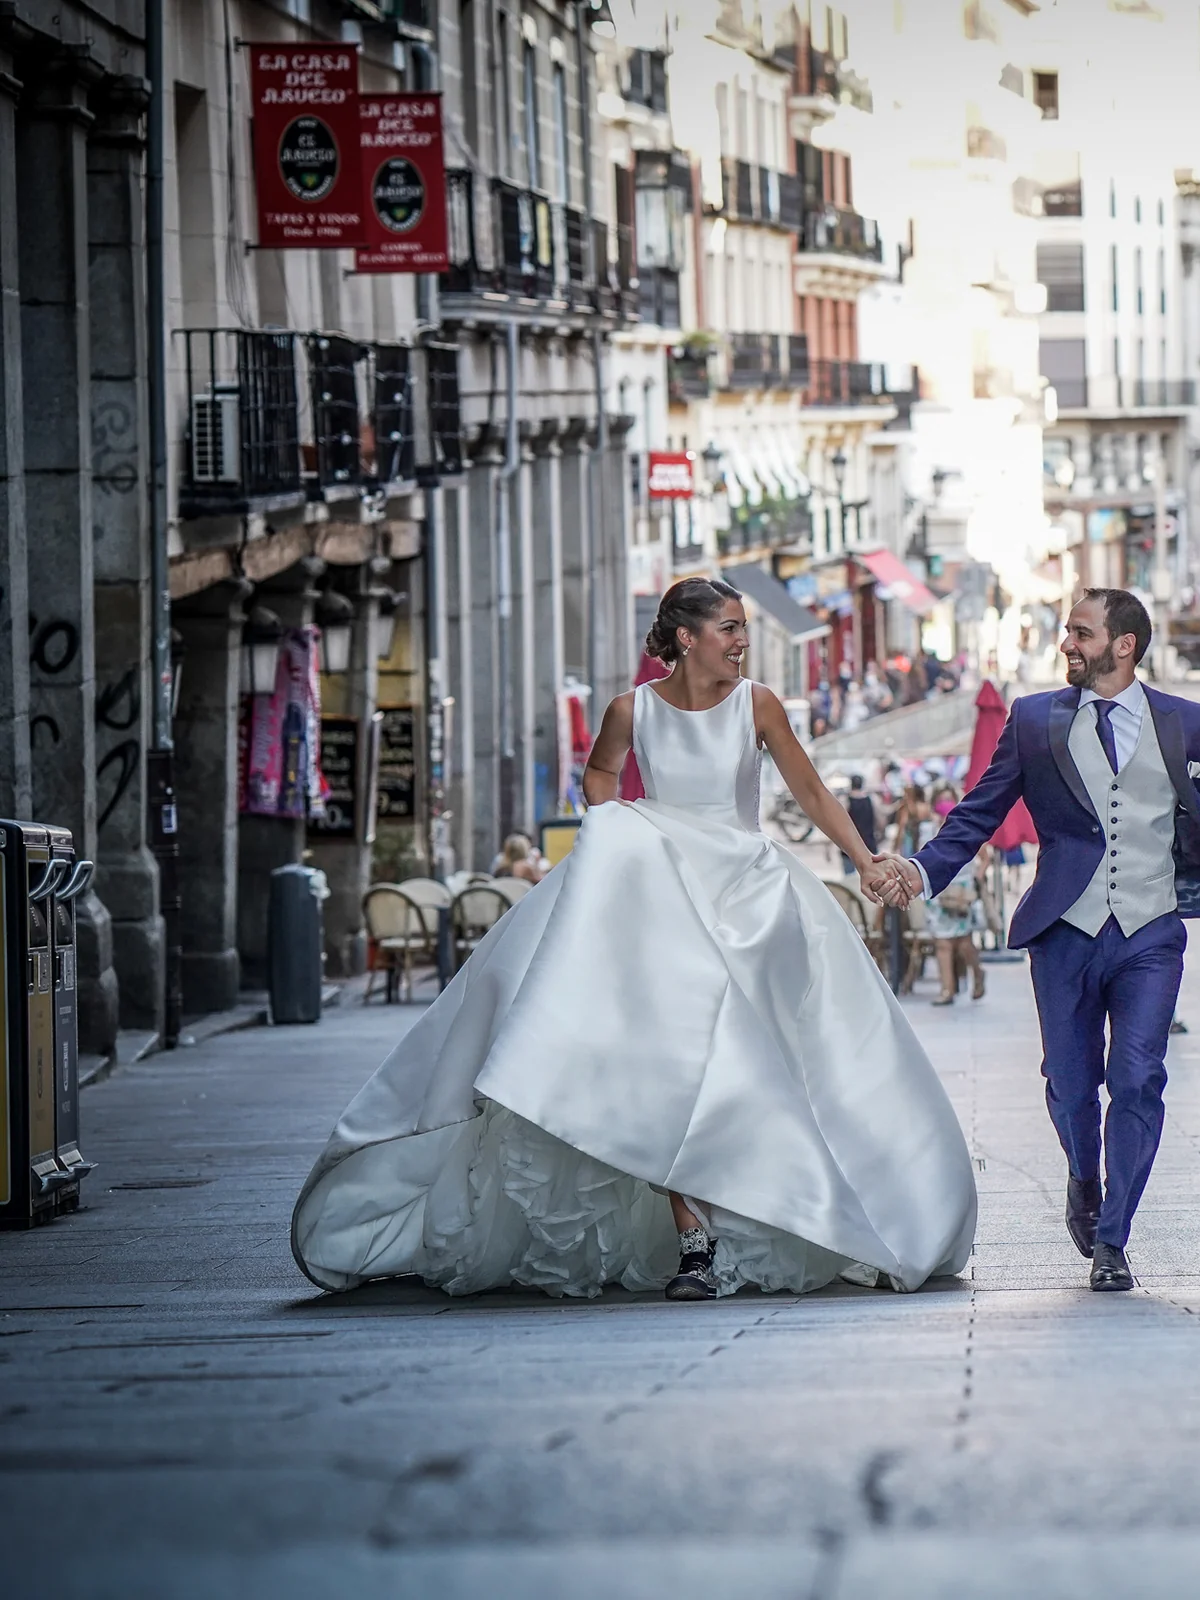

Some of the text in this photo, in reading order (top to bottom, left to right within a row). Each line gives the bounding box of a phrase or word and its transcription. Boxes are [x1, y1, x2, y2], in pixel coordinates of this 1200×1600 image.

[259, 54, 351, 71] LA CASA
[285, 71, 327, 87] DEL
[261, 87, 346, 104] ABUELO
[359, 101, 436, 119] LA CASA
[377, 117, 415, 132] DEL
[359, 131, 432, 148] ABUELO
[306, 212, 316, 225] Y
[318, 212, 361, 225] VINOS
